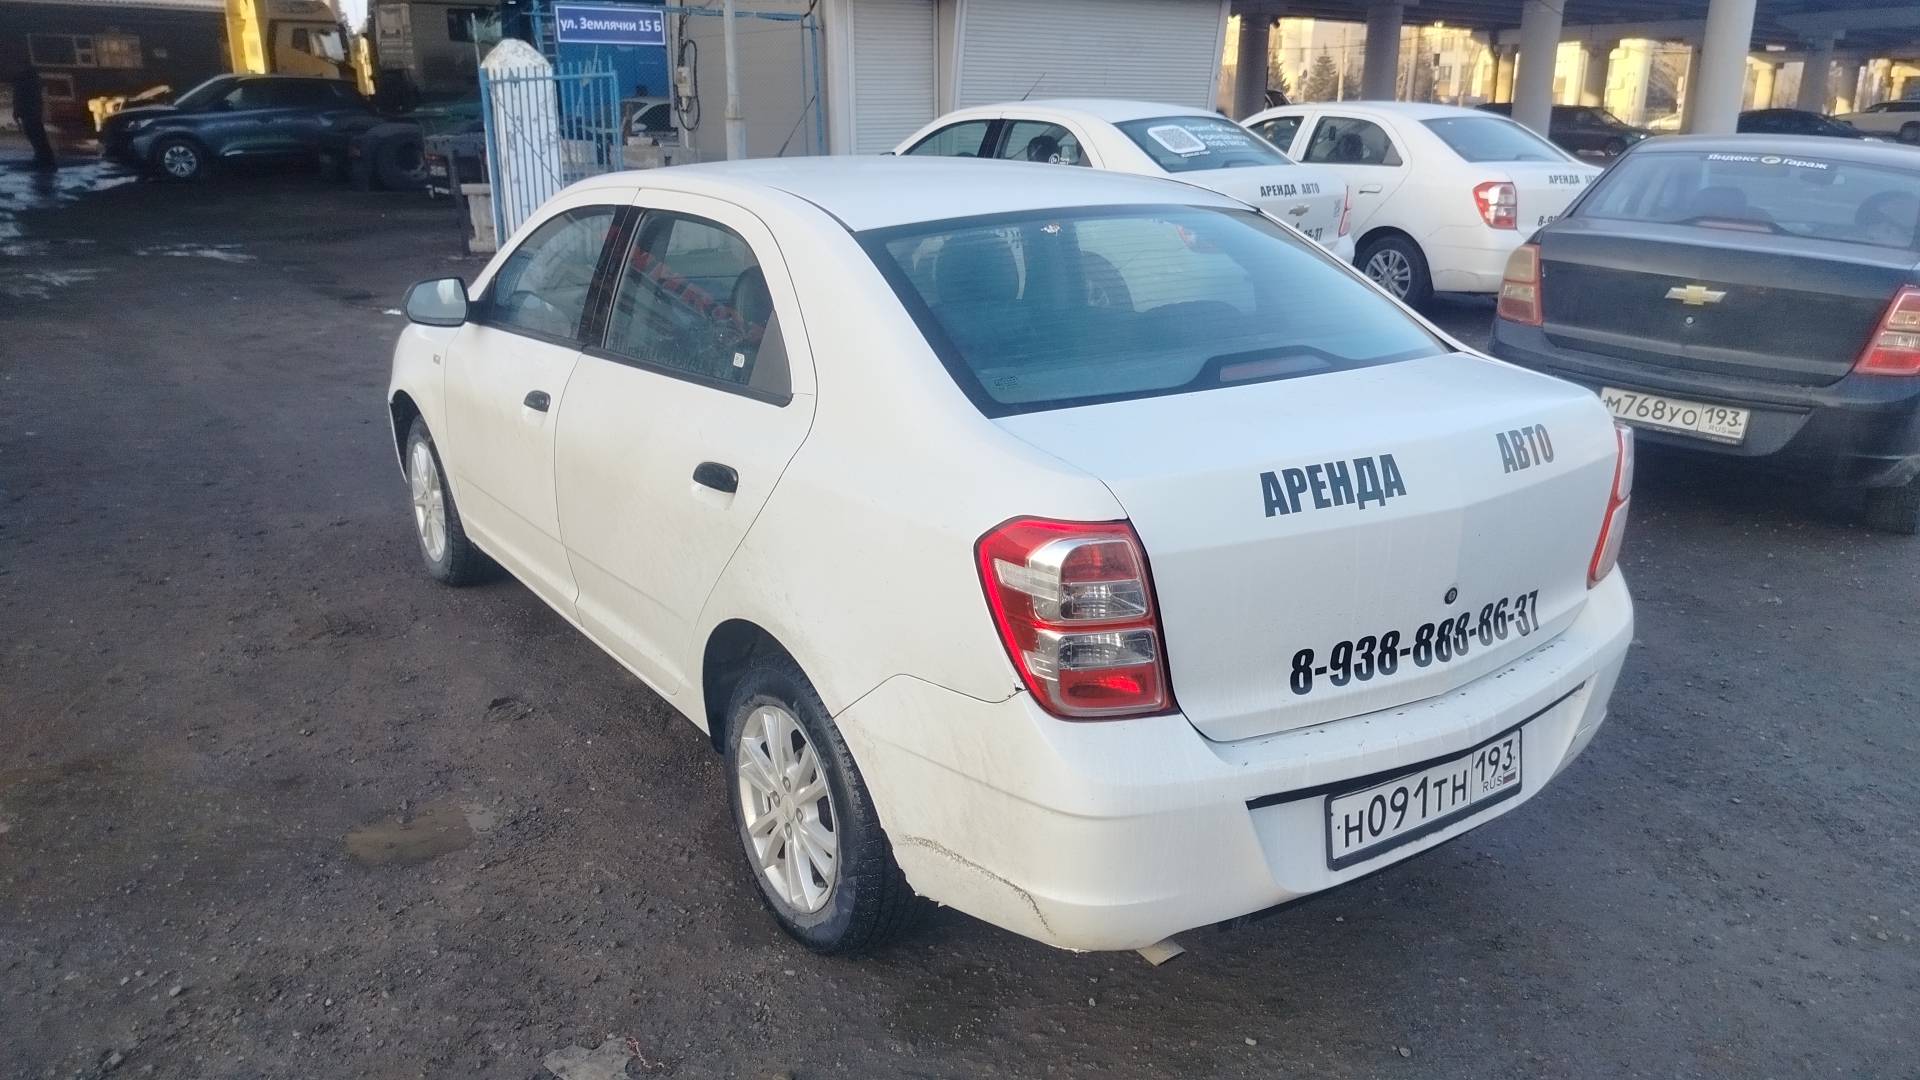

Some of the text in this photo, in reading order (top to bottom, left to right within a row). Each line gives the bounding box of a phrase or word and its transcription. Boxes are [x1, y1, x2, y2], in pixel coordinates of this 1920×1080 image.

[560, 17, 662, 32] ул. Землячки 15 Б
[1707, 152, 1760, 162] Яндекс
[1548, 174, 1581, 186] АРЕНДА
[1260, 182, 1320, 197] АРЕНДА АВТО
[1605, 393, 1741, 428] М768УО 193
[1260, 423, 1554, 518] АРЕНДА АВТО
[1289, 588, 1540, 696] 8-938-888-86-37
[1343, 738, 1513, 848] Н091ТН 193
[1482, 775, 1504, 793] RUS
